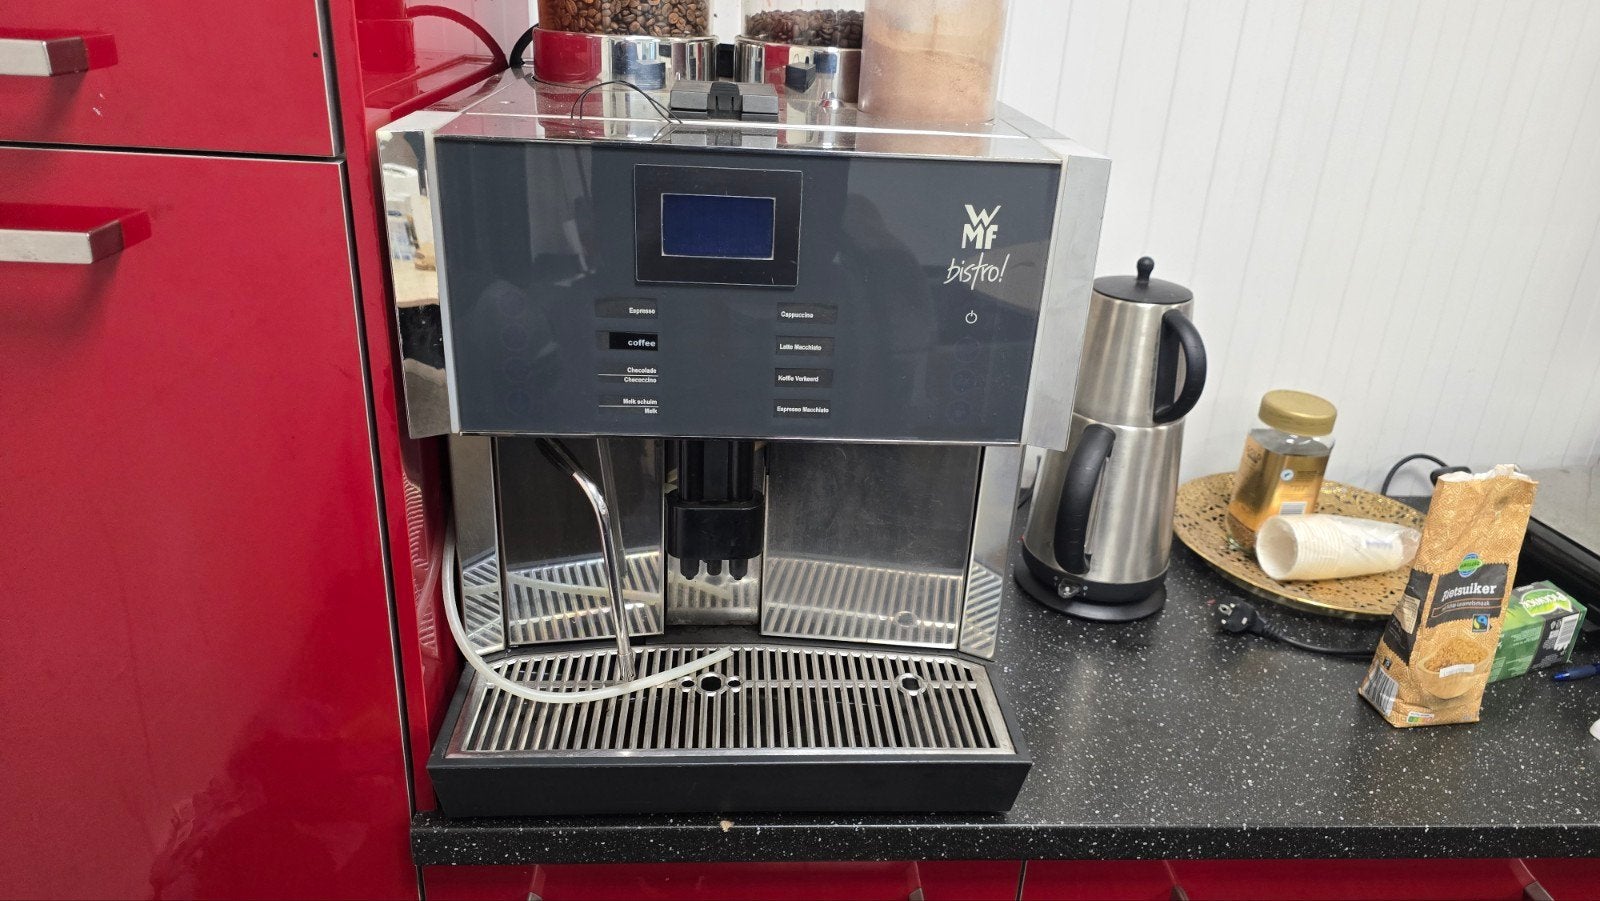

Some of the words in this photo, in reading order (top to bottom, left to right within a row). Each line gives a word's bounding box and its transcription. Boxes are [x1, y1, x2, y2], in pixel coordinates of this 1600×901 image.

[943, 252, 1011, 291] bistro!
[629, 307, 656, 315] Espresso
[780, 311, 814, 319] Cappuccino
[628, 339, 656, 347] coffee
[795, 375, 819, 383] Verkeerd
[802, 406, 830, 414] Macchiato
[1441, 582, 1498, 603] Rietsuiker
